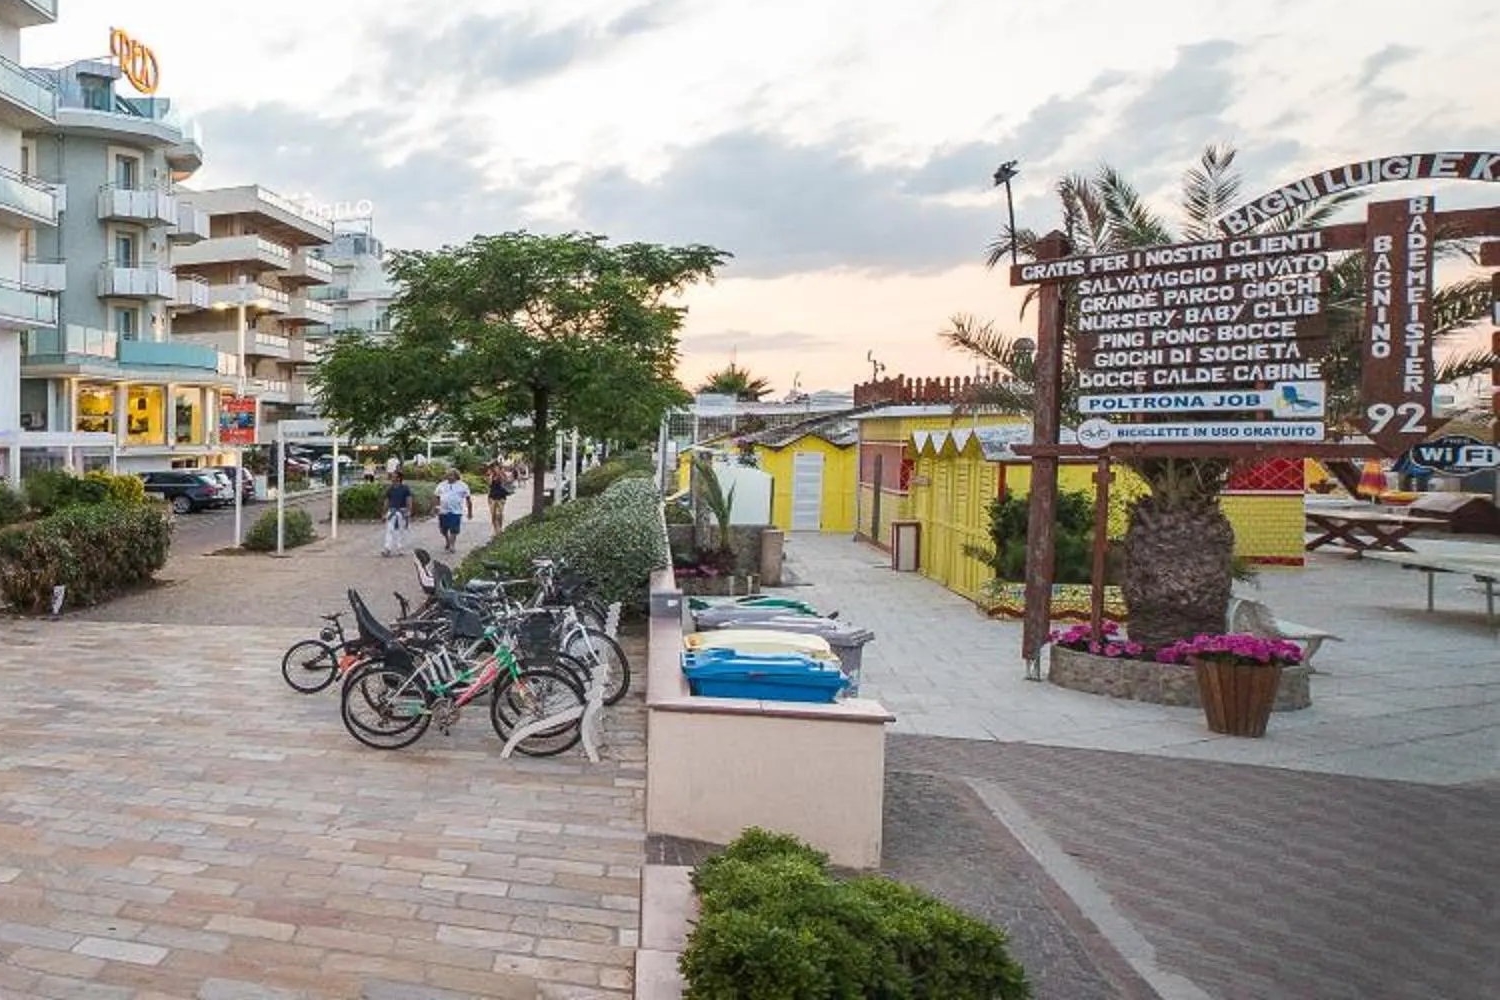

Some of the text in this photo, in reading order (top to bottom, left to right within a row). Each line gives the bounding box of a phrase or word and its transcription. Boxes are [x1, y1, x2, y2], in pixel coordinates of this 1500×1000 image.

[1223, 176, 1321, 235] BAGNI
[1322, 155, 1421, 193] LUIGI
[1429, 153, 1465, 178] E
[1021, 231, 1322, 282] GRATIS PER I NOSTRI CLIENTI
[1077, 254, 1326, 296] SALVATAGGIO PRIVATO
[1080, 278, 1322, 314] GRANDE PARCO GIOCHI
[1253, 298, 1320, 319] CLUB
[1371, 235, 1393, 359] BAGNINO
[1404, 197, 1429, 393] BADEMEISTER
[1094, 342, 1301, 368] GIOCHI DI SOCIETA
[1098, 332, 1145, 349] PING
[1079, 371, 1147, 388] DOCCE
[1089, 394, 1261, 410] POLTRONA JOB
[1366, 402, 1428, 434] 92
[1116, 426, 1317, 438] BICICLETTE IN USO GRATUITO
